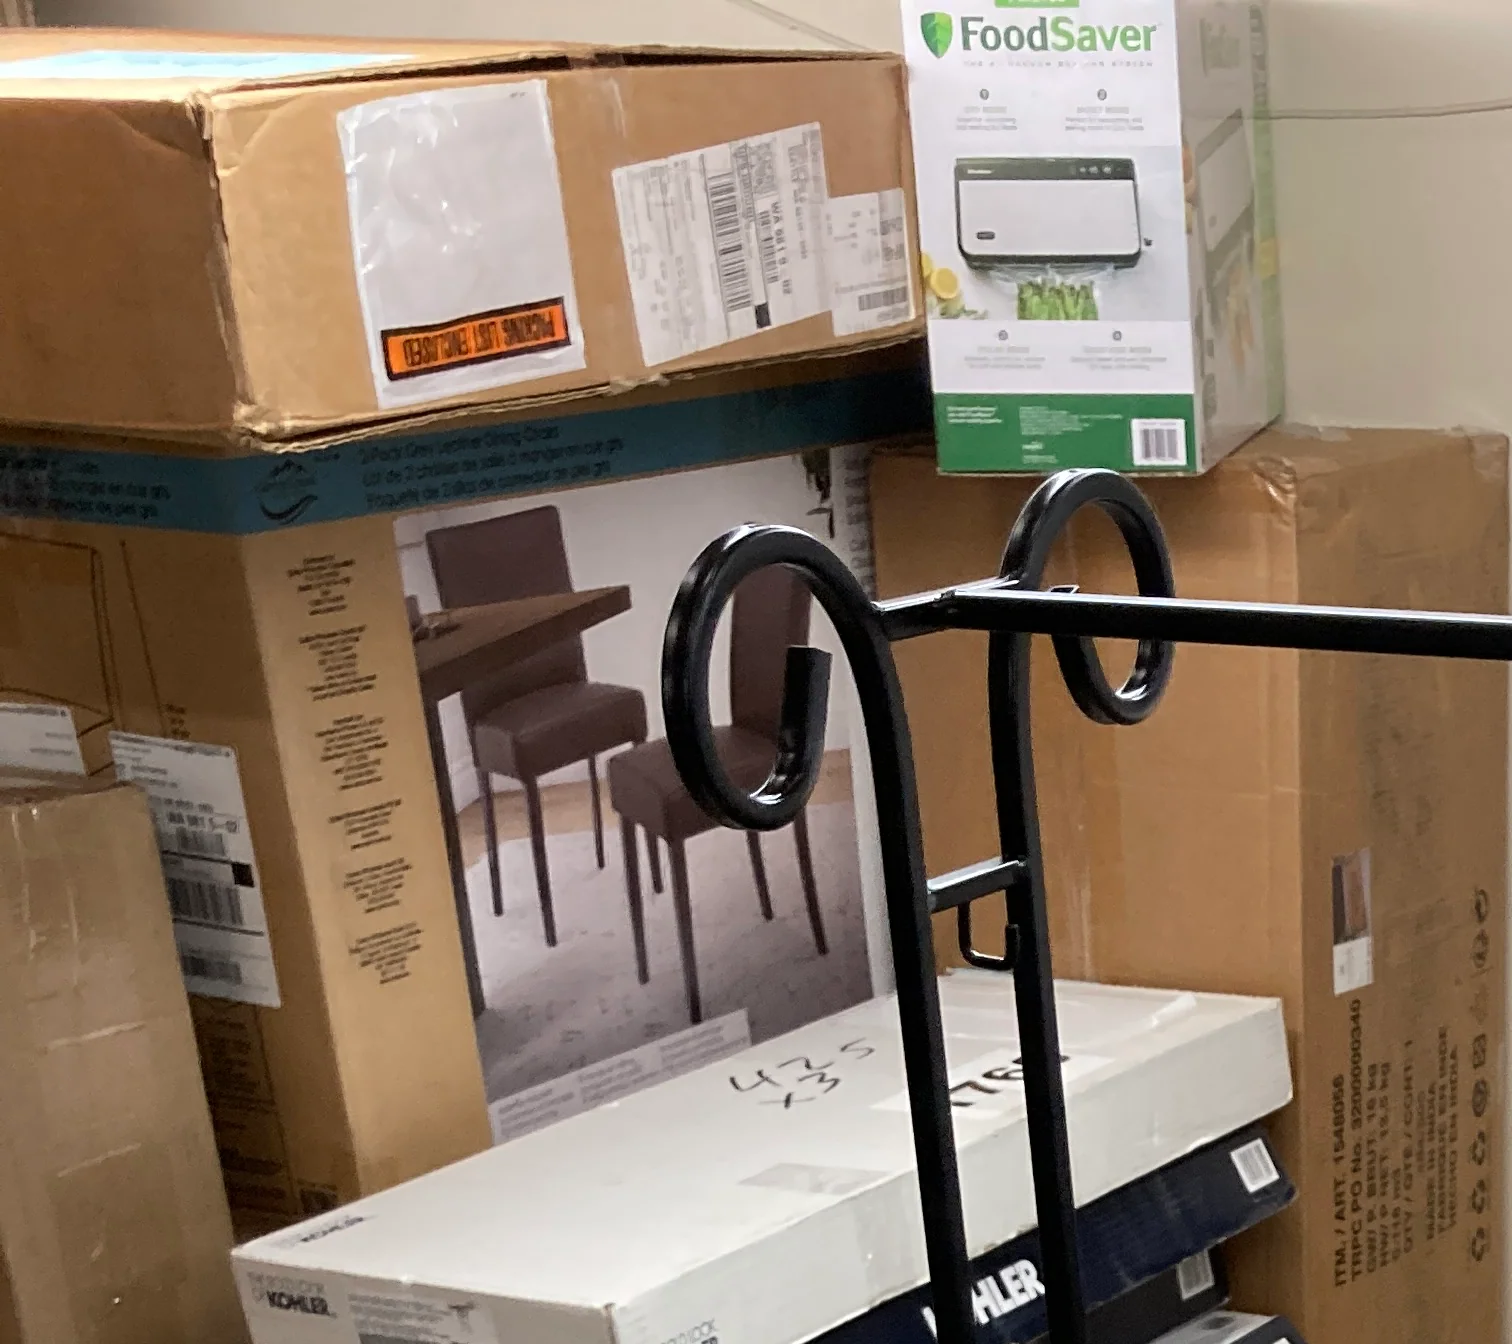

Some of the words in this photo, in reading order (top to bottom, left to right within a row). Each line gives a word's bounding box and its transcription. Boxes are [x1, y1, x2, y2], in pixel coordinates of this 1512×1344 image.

[960, 16, 1156, 52] FoodSaver
[1333, 1172, 1346, 1222] ART.
[1350, 1180, 1362, 1212] PO
[1334, 1241, 1347, 1287] ITM.
[1350, 1220, 1362, 1283] TRPC
[266, 1290, 330, 1316] KOHLER
[922, 1259, 1045, 1341] HLER
